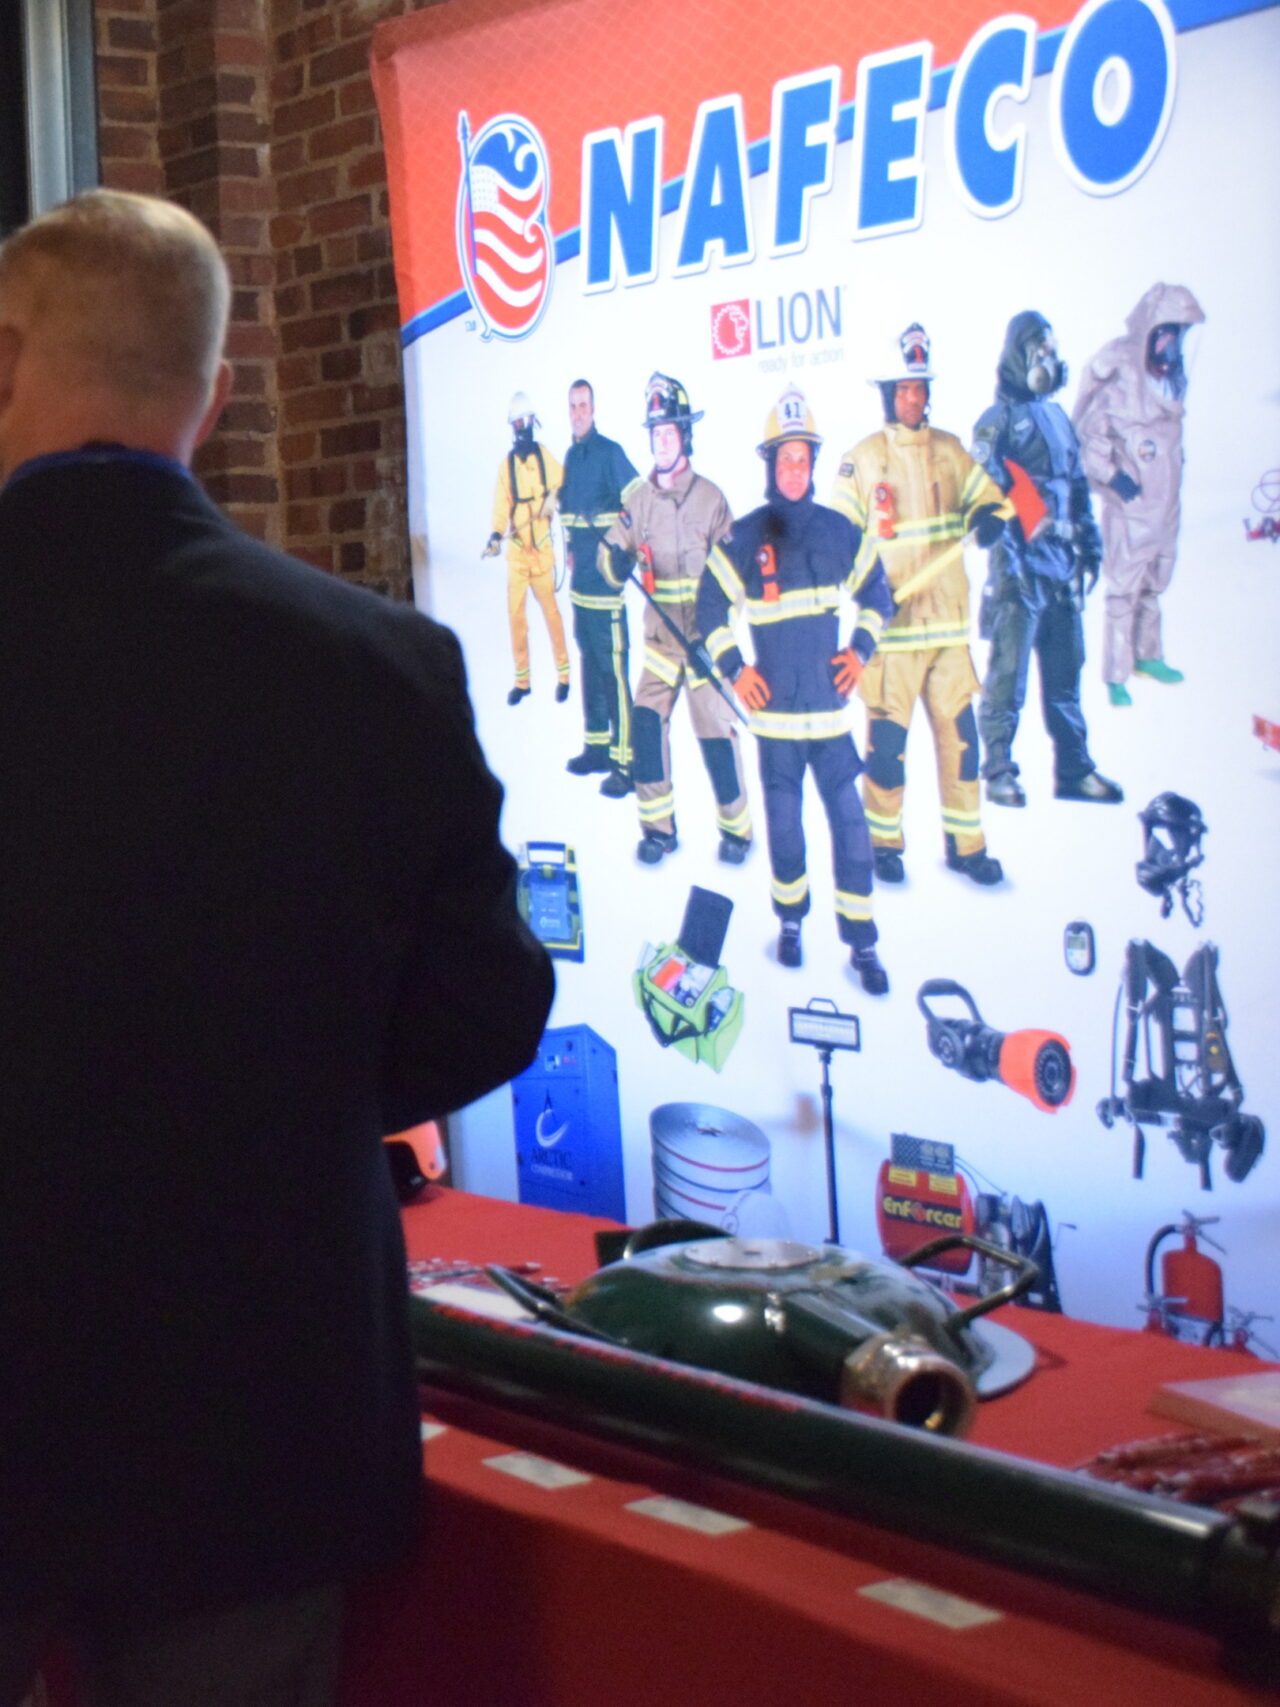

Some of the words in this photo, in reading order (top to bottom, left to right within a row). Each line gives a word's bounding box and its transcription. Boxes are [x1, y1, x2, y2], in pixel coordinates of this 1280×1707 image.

[583, 0, 1174, 290] NAFECO
[756, 286, 842, 349] LION
[757, 355, 788, 373] ready
[792, 352, 805, 367] for
[810, 348, 844, 366] action
